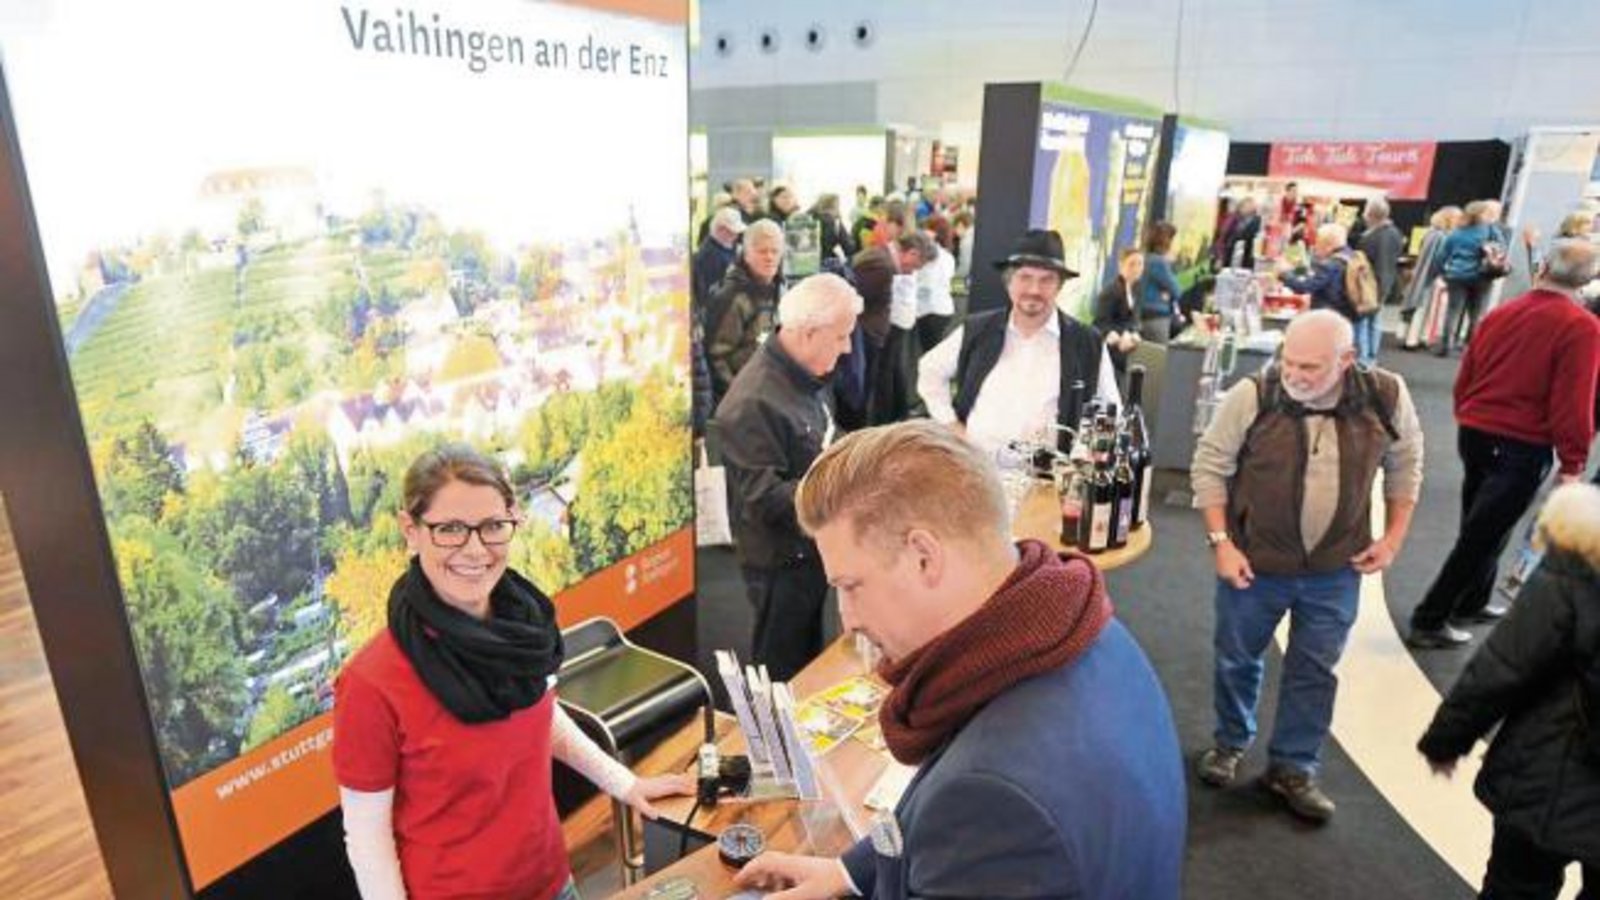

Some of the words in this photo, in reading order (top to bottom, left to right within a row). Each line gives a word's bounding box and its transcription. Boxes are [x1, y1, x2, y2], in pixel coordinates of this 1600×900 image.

[341, 6, 524, 73] Vaihingen
[535, 38, 567, 67] an
[579, 35, 621, 73] der
[630, 44, 668, 77] Enz
